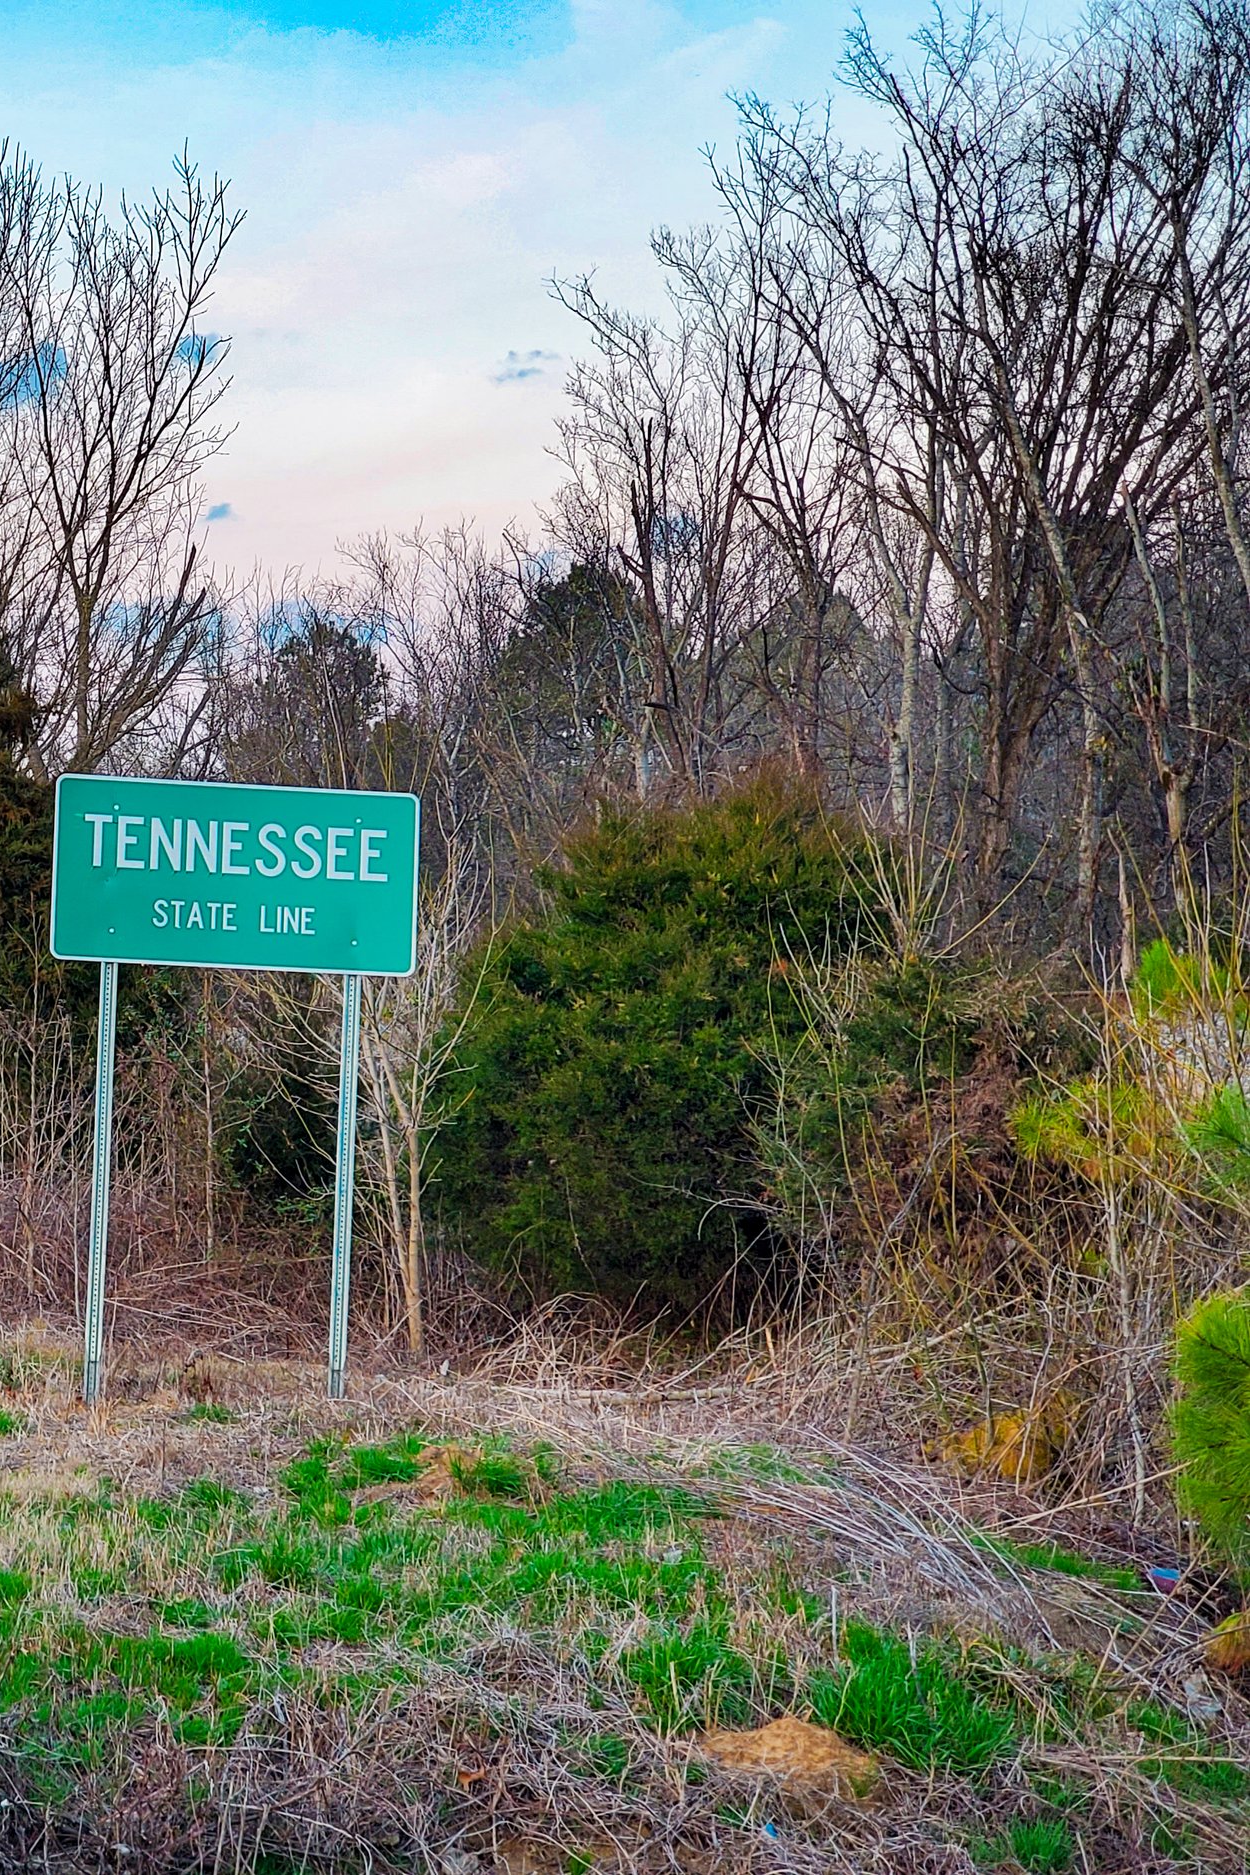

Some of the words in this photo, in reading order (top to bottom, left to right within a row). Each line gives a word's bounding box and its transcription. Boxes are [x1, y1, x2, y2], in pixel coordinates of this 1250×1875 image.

[84, 813, 388, 882] TENNESSEE
[152, 899, 237, 931] STATE
[260, 905, 316, 935] LINE
